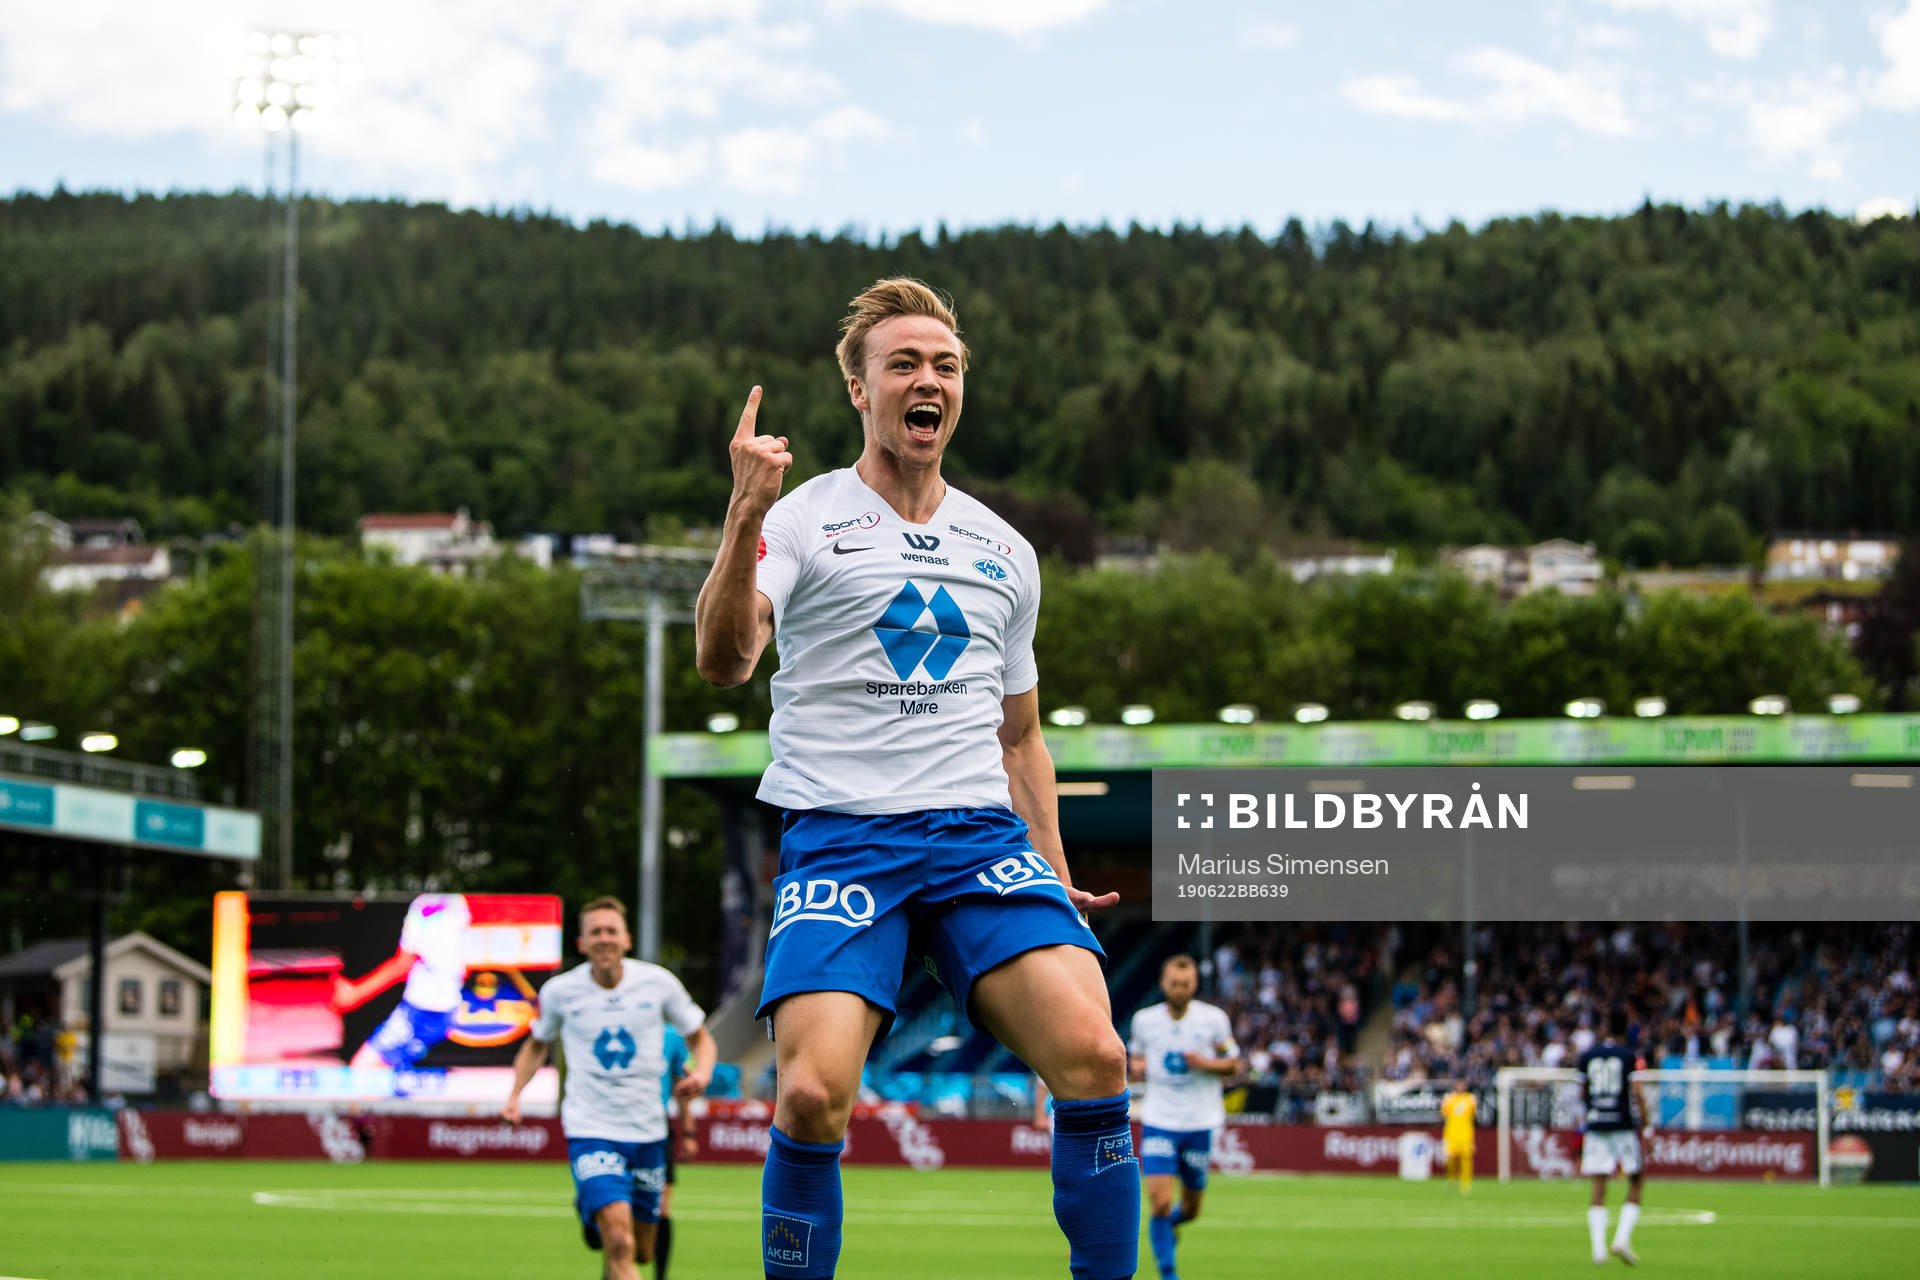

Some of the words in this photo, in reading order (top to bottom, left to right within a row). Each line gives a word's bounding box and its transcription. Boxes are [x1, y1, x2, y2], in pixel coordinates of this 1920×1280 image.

[822, 517, 861, 532] sport
[948, 524, 992, 546] sport
[900, 552, 949, 566] wenaas
[866, 680, 968, 698] Sparebanken
[900, 700, 939, 715] Møre
[429, 1121, 548, 1155] Regnskap
[767, 1246, 802, 1262] AKER
